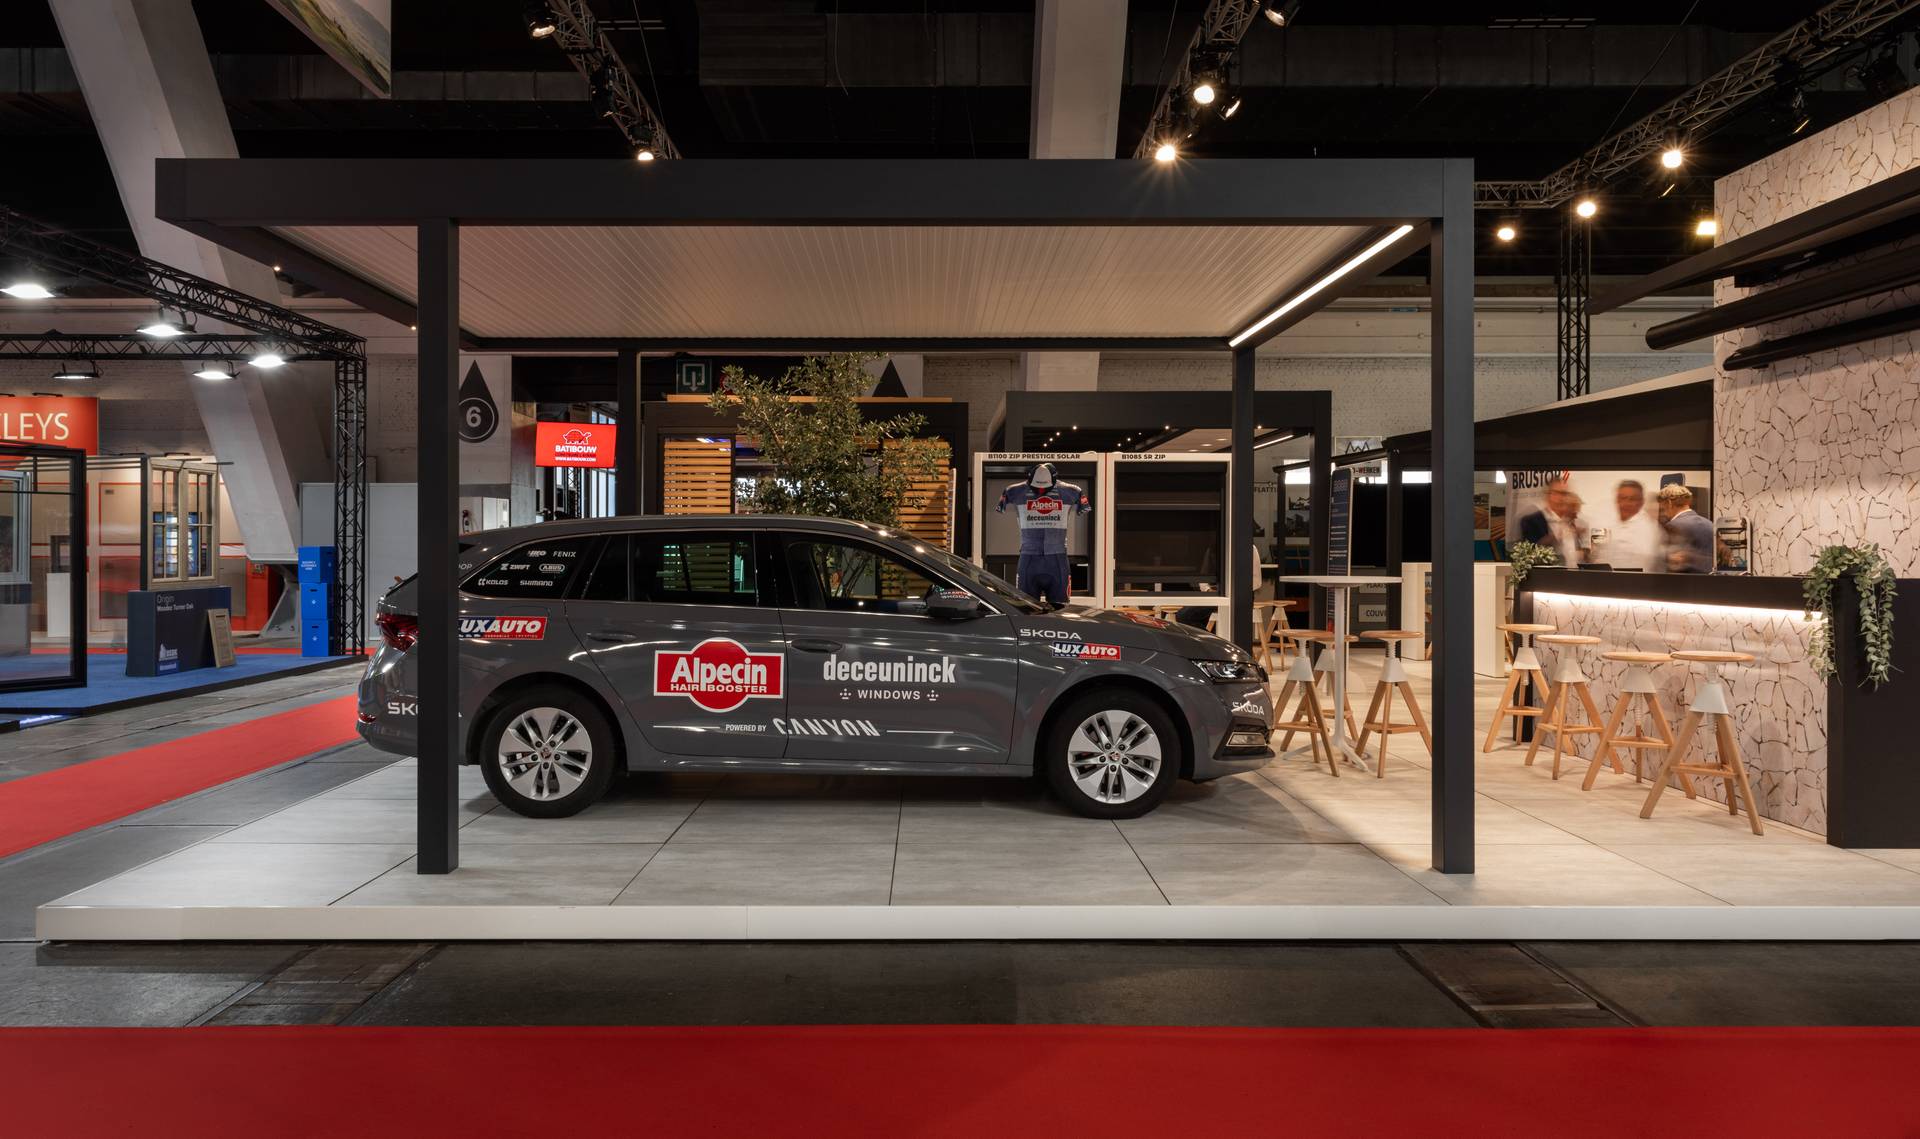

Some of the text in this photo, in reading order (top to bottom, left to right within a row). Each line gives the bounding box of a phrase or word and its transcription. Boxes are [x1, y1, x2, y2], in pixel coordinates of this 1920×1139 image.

[466, 406, 482, 428] 6
[0, 412, 70, 441] LEYS
[554, 445, 598, 454] BATIBOUW
[1031, 501, 1059, 510] Alpecin
[458, 619, 542, 634] UXAUTO
[1054, 643, 1118, 656] LUXAUTO
[670, 656, 768, 692] Alpecin
[823, 654, 956, 684] deceuninck
[670, 683, 768, 693] HAIR BOOSTER
[857, 689, 921, 700] WINDOWS
[725, 724, 767, 732] POWERED BY
[772, 717, 881, 737] CANYON
